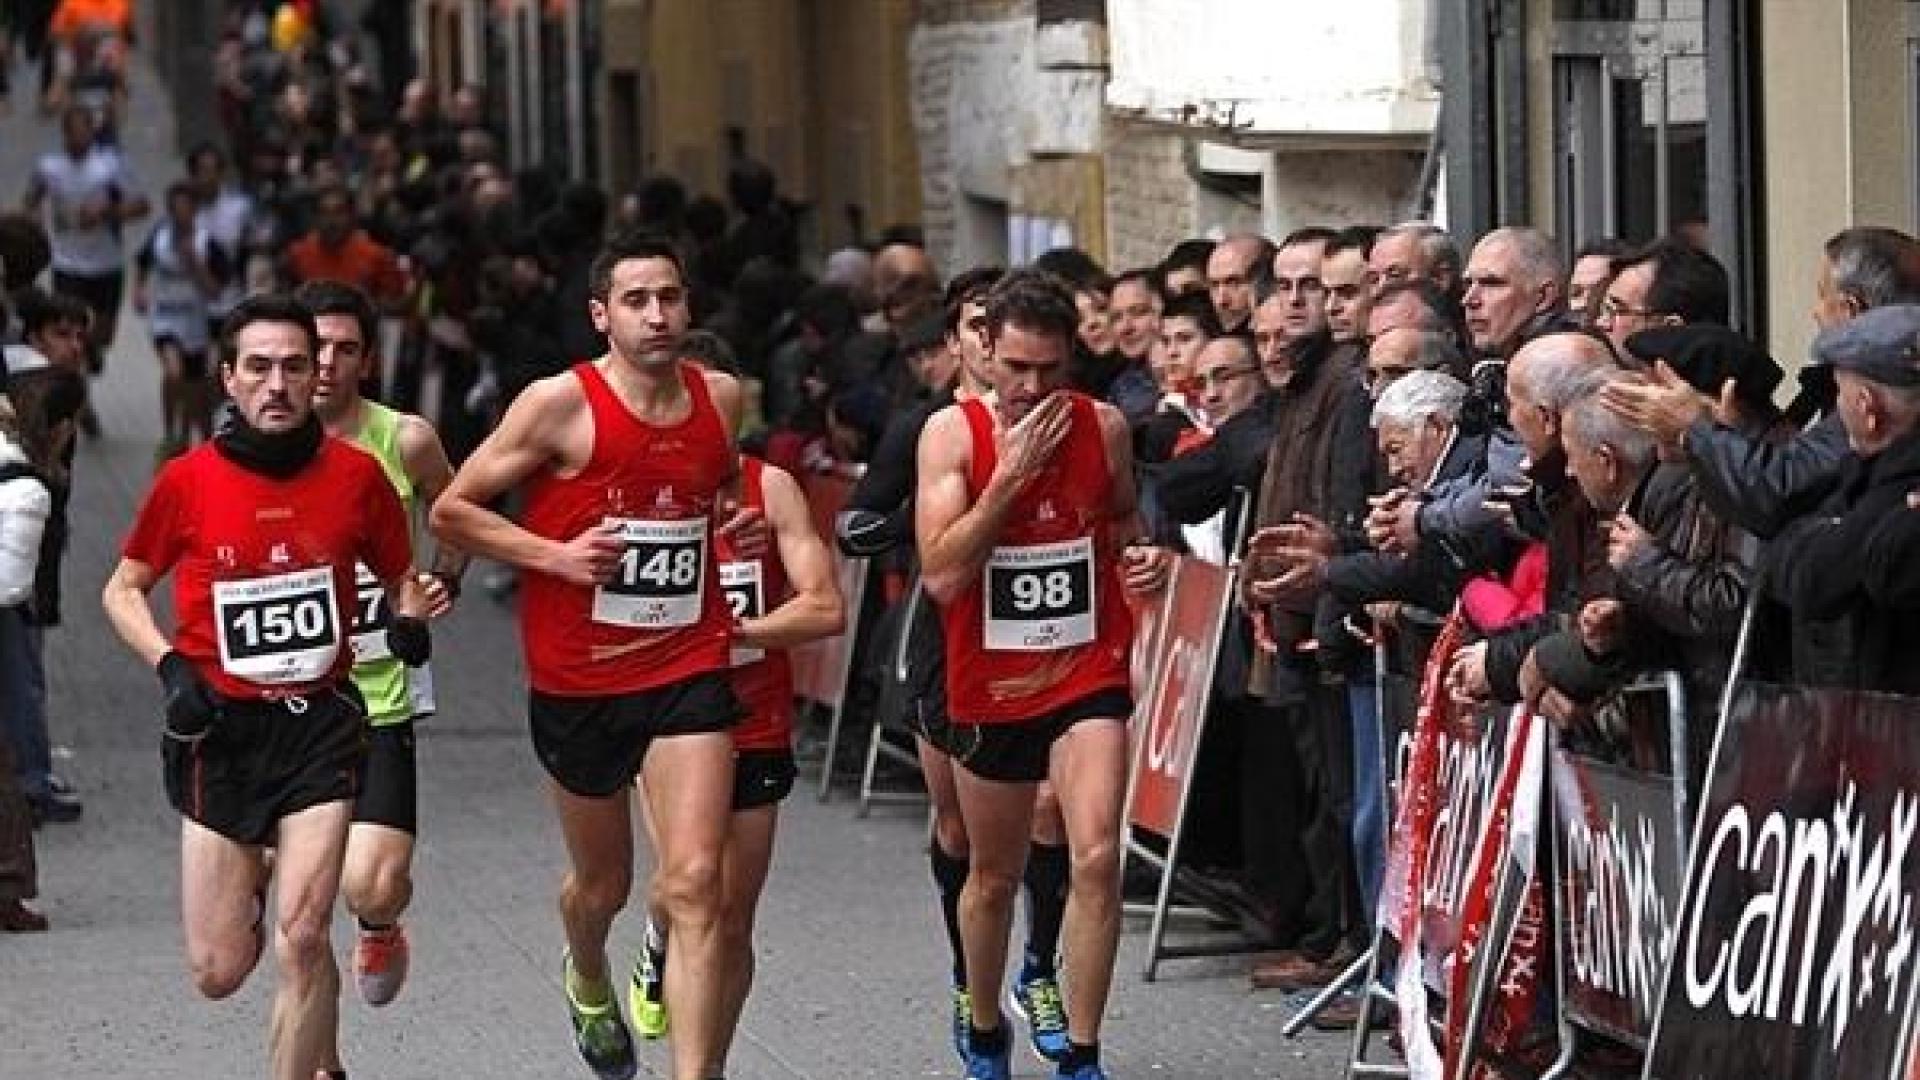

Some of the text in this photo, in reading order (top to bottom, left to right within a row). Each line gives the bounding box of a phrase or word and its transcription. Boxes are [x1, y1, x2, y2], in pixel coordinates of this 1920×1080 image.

[620, 548, 695, 586] 148
[1012, 571, 1072, 611] 98
[233, 600, 325, 646] 150
